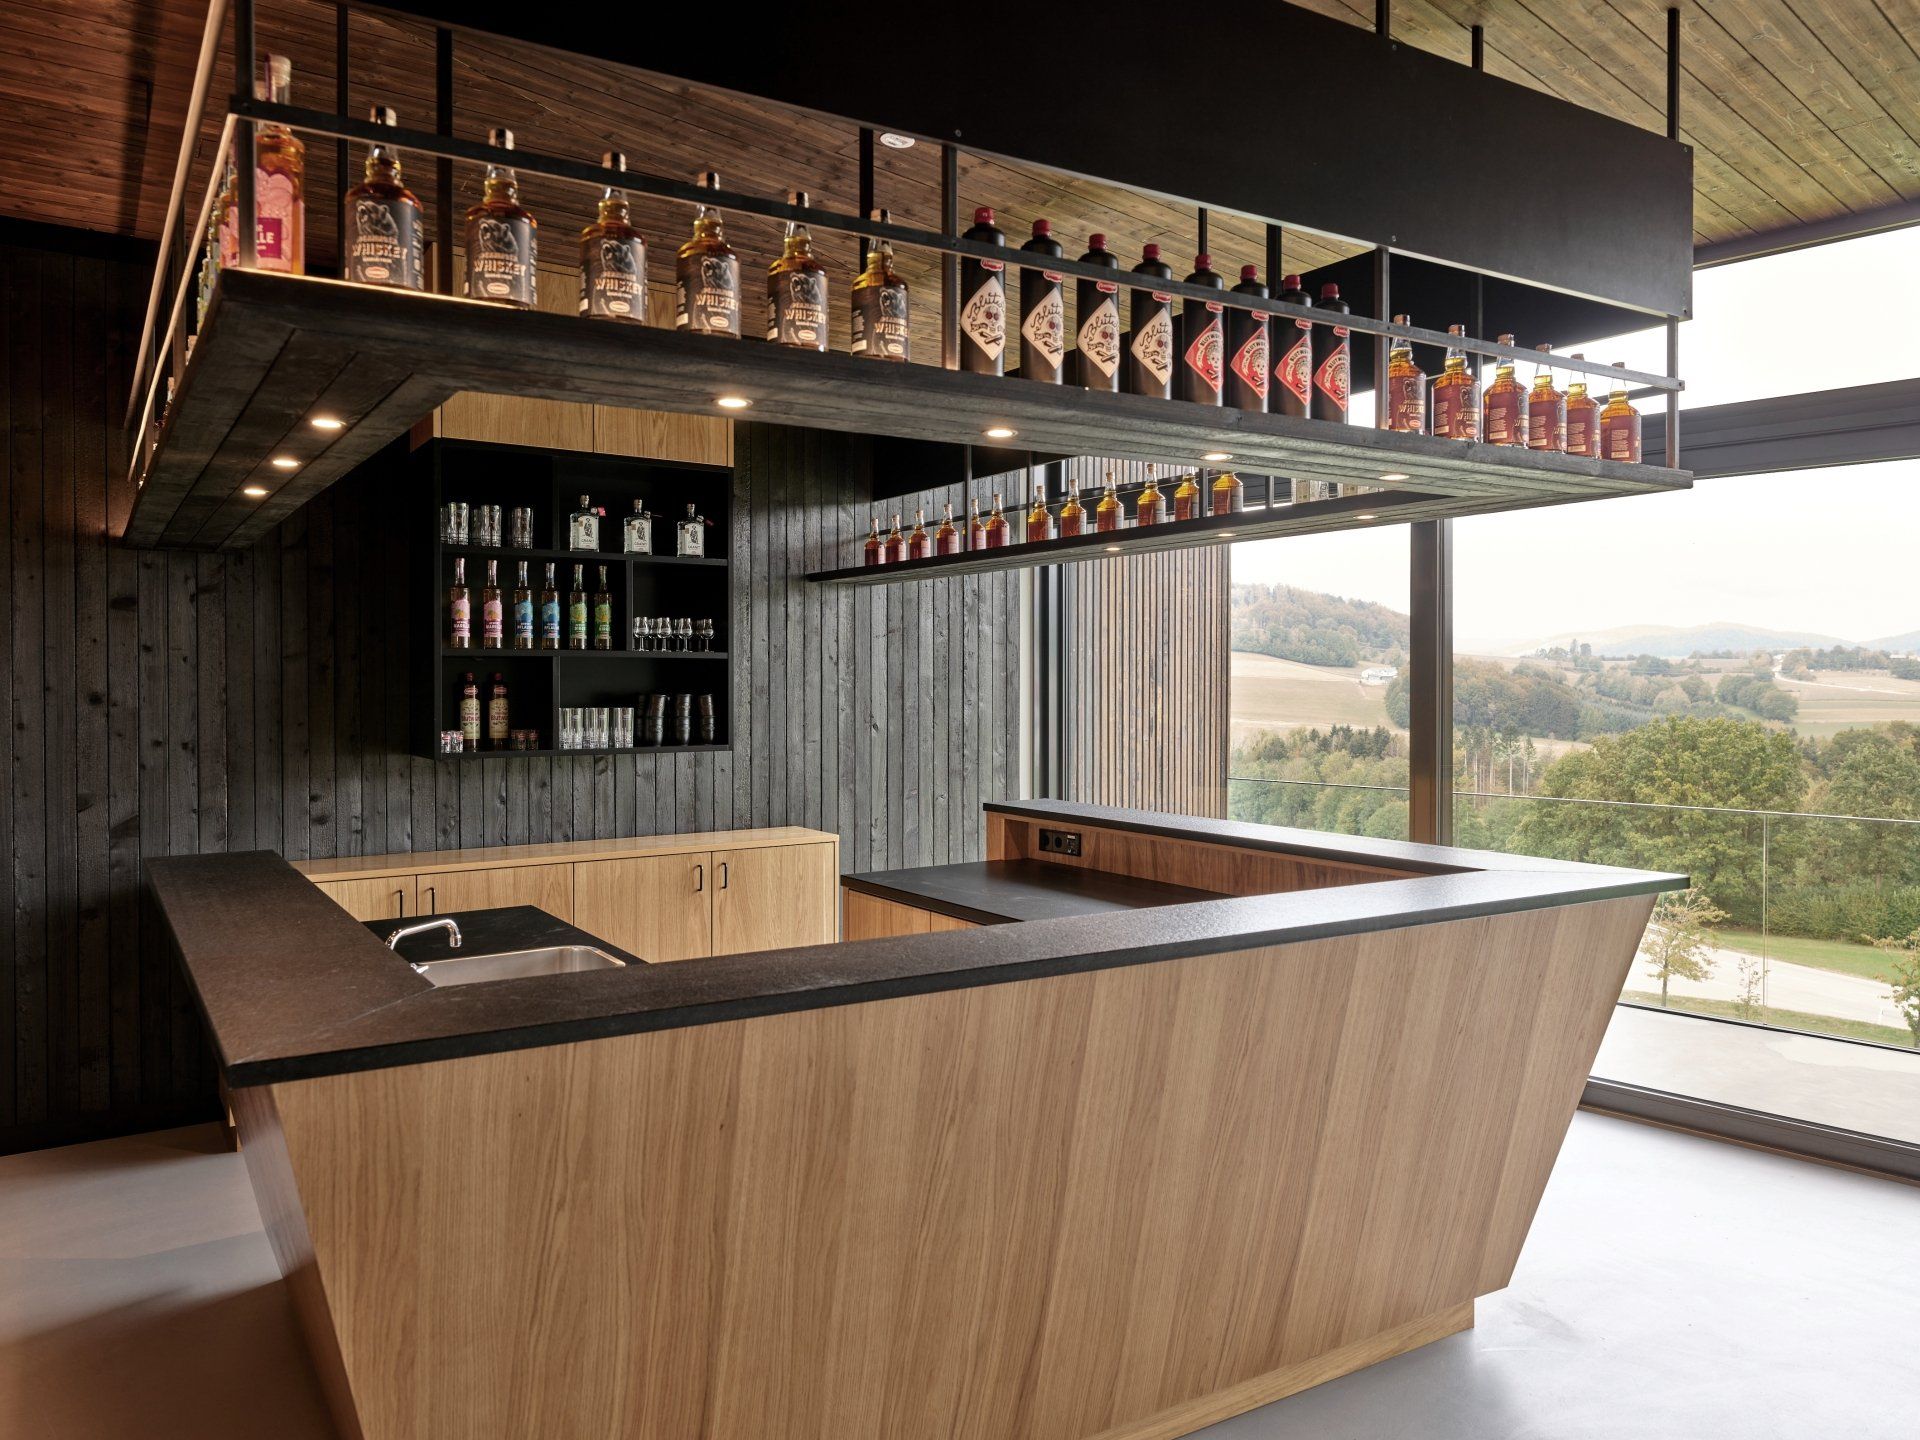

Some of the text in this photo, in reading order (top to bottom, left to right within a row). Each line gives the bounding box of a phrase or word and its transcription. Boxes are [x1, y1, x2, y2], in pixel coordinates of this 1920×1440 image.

[352, 244, 407, 260] WHISKEY
[474, 259, 526, 277] WHISKEY
[595, 278, 643, 295] WHISKEY
